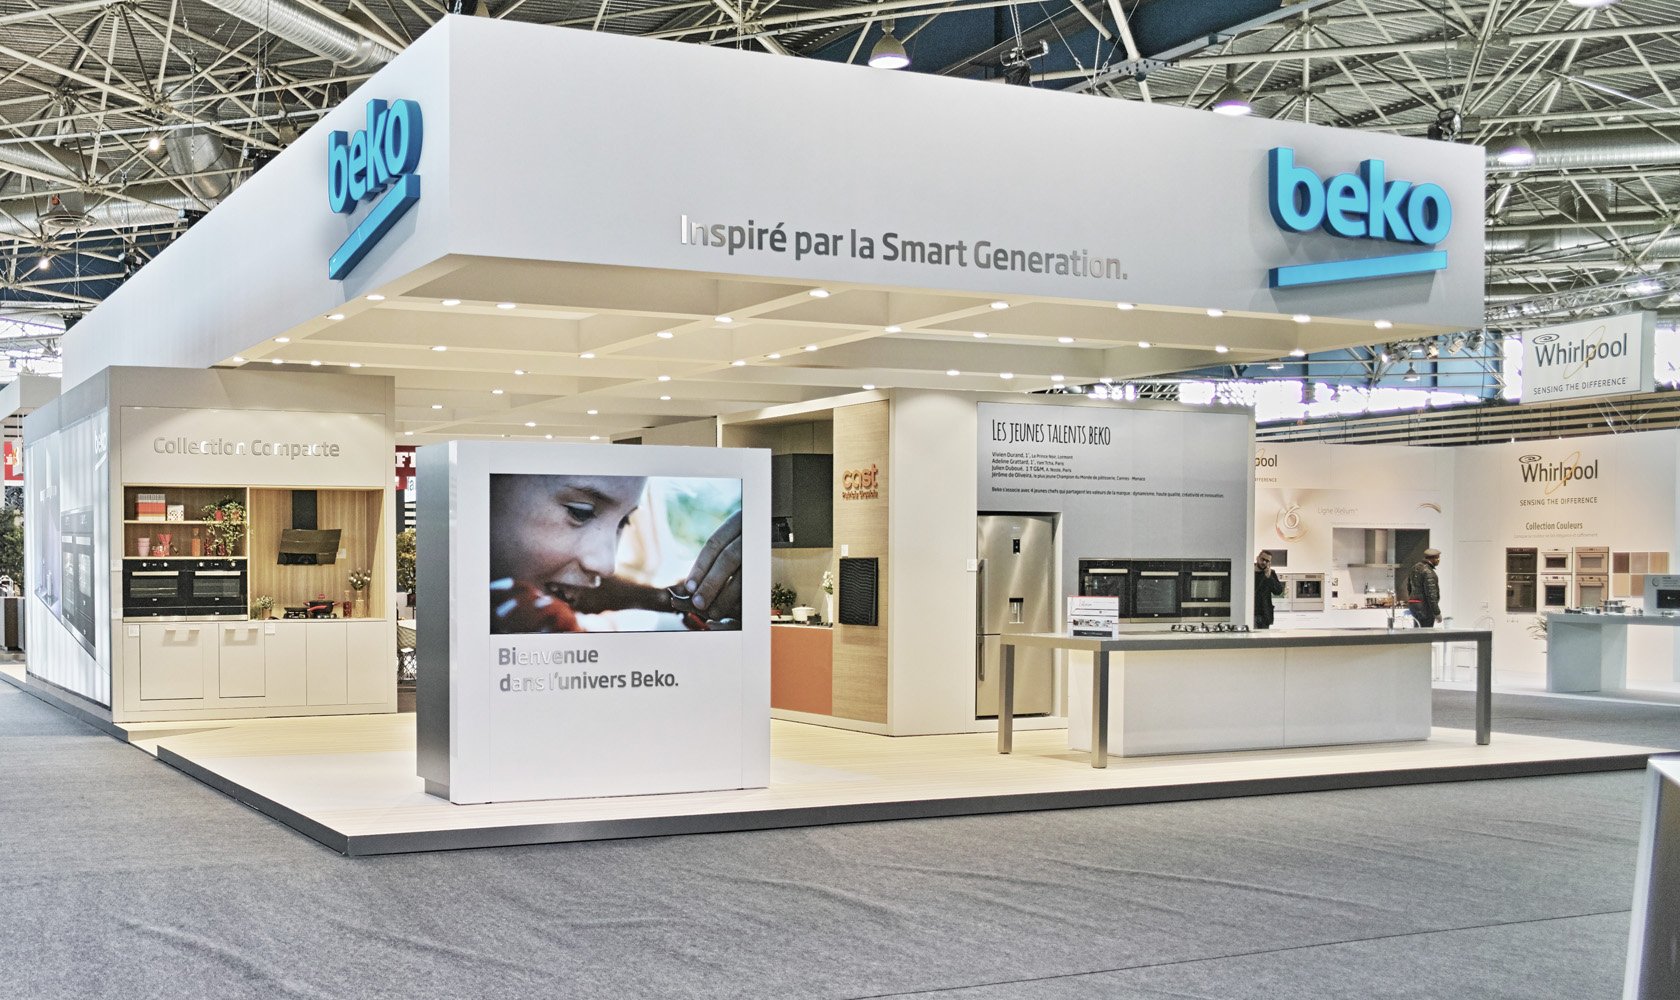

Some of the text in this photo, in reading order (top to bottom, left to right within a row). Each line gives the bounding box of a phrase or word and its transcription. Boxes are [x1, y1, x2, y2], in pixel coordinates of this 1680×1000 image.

[328, 98, 423, 214] beko
[1268, 147, 1452, 244] beko
[681, 214, 1128, 280] Inspiré par la Smart Generation.
[1535, 333, 1627, 368] Whirlpool
[1534, 377, 1627, 396] SENSING THE DIFFERENCE
[1047, 424, 1087, 445] TALENTS
[1088, 426, 1111, 446] BEKO
[153, 437, 341, 460] Collection Compacte
[843, 463, 878, 490] cast
[1521, 459, 1598, 486] Whirlpool
[1519, 499, 1545, 507] SENSING
[1560, 497, 1598, 505] DIFFERENCE
[1525, 521, 1583, 531] Collection Couleurs
[498, 647, 599, 666] Bienvenue
[499, 673, 545, 692] dans
[631, 670, 679, 688] Beko.
